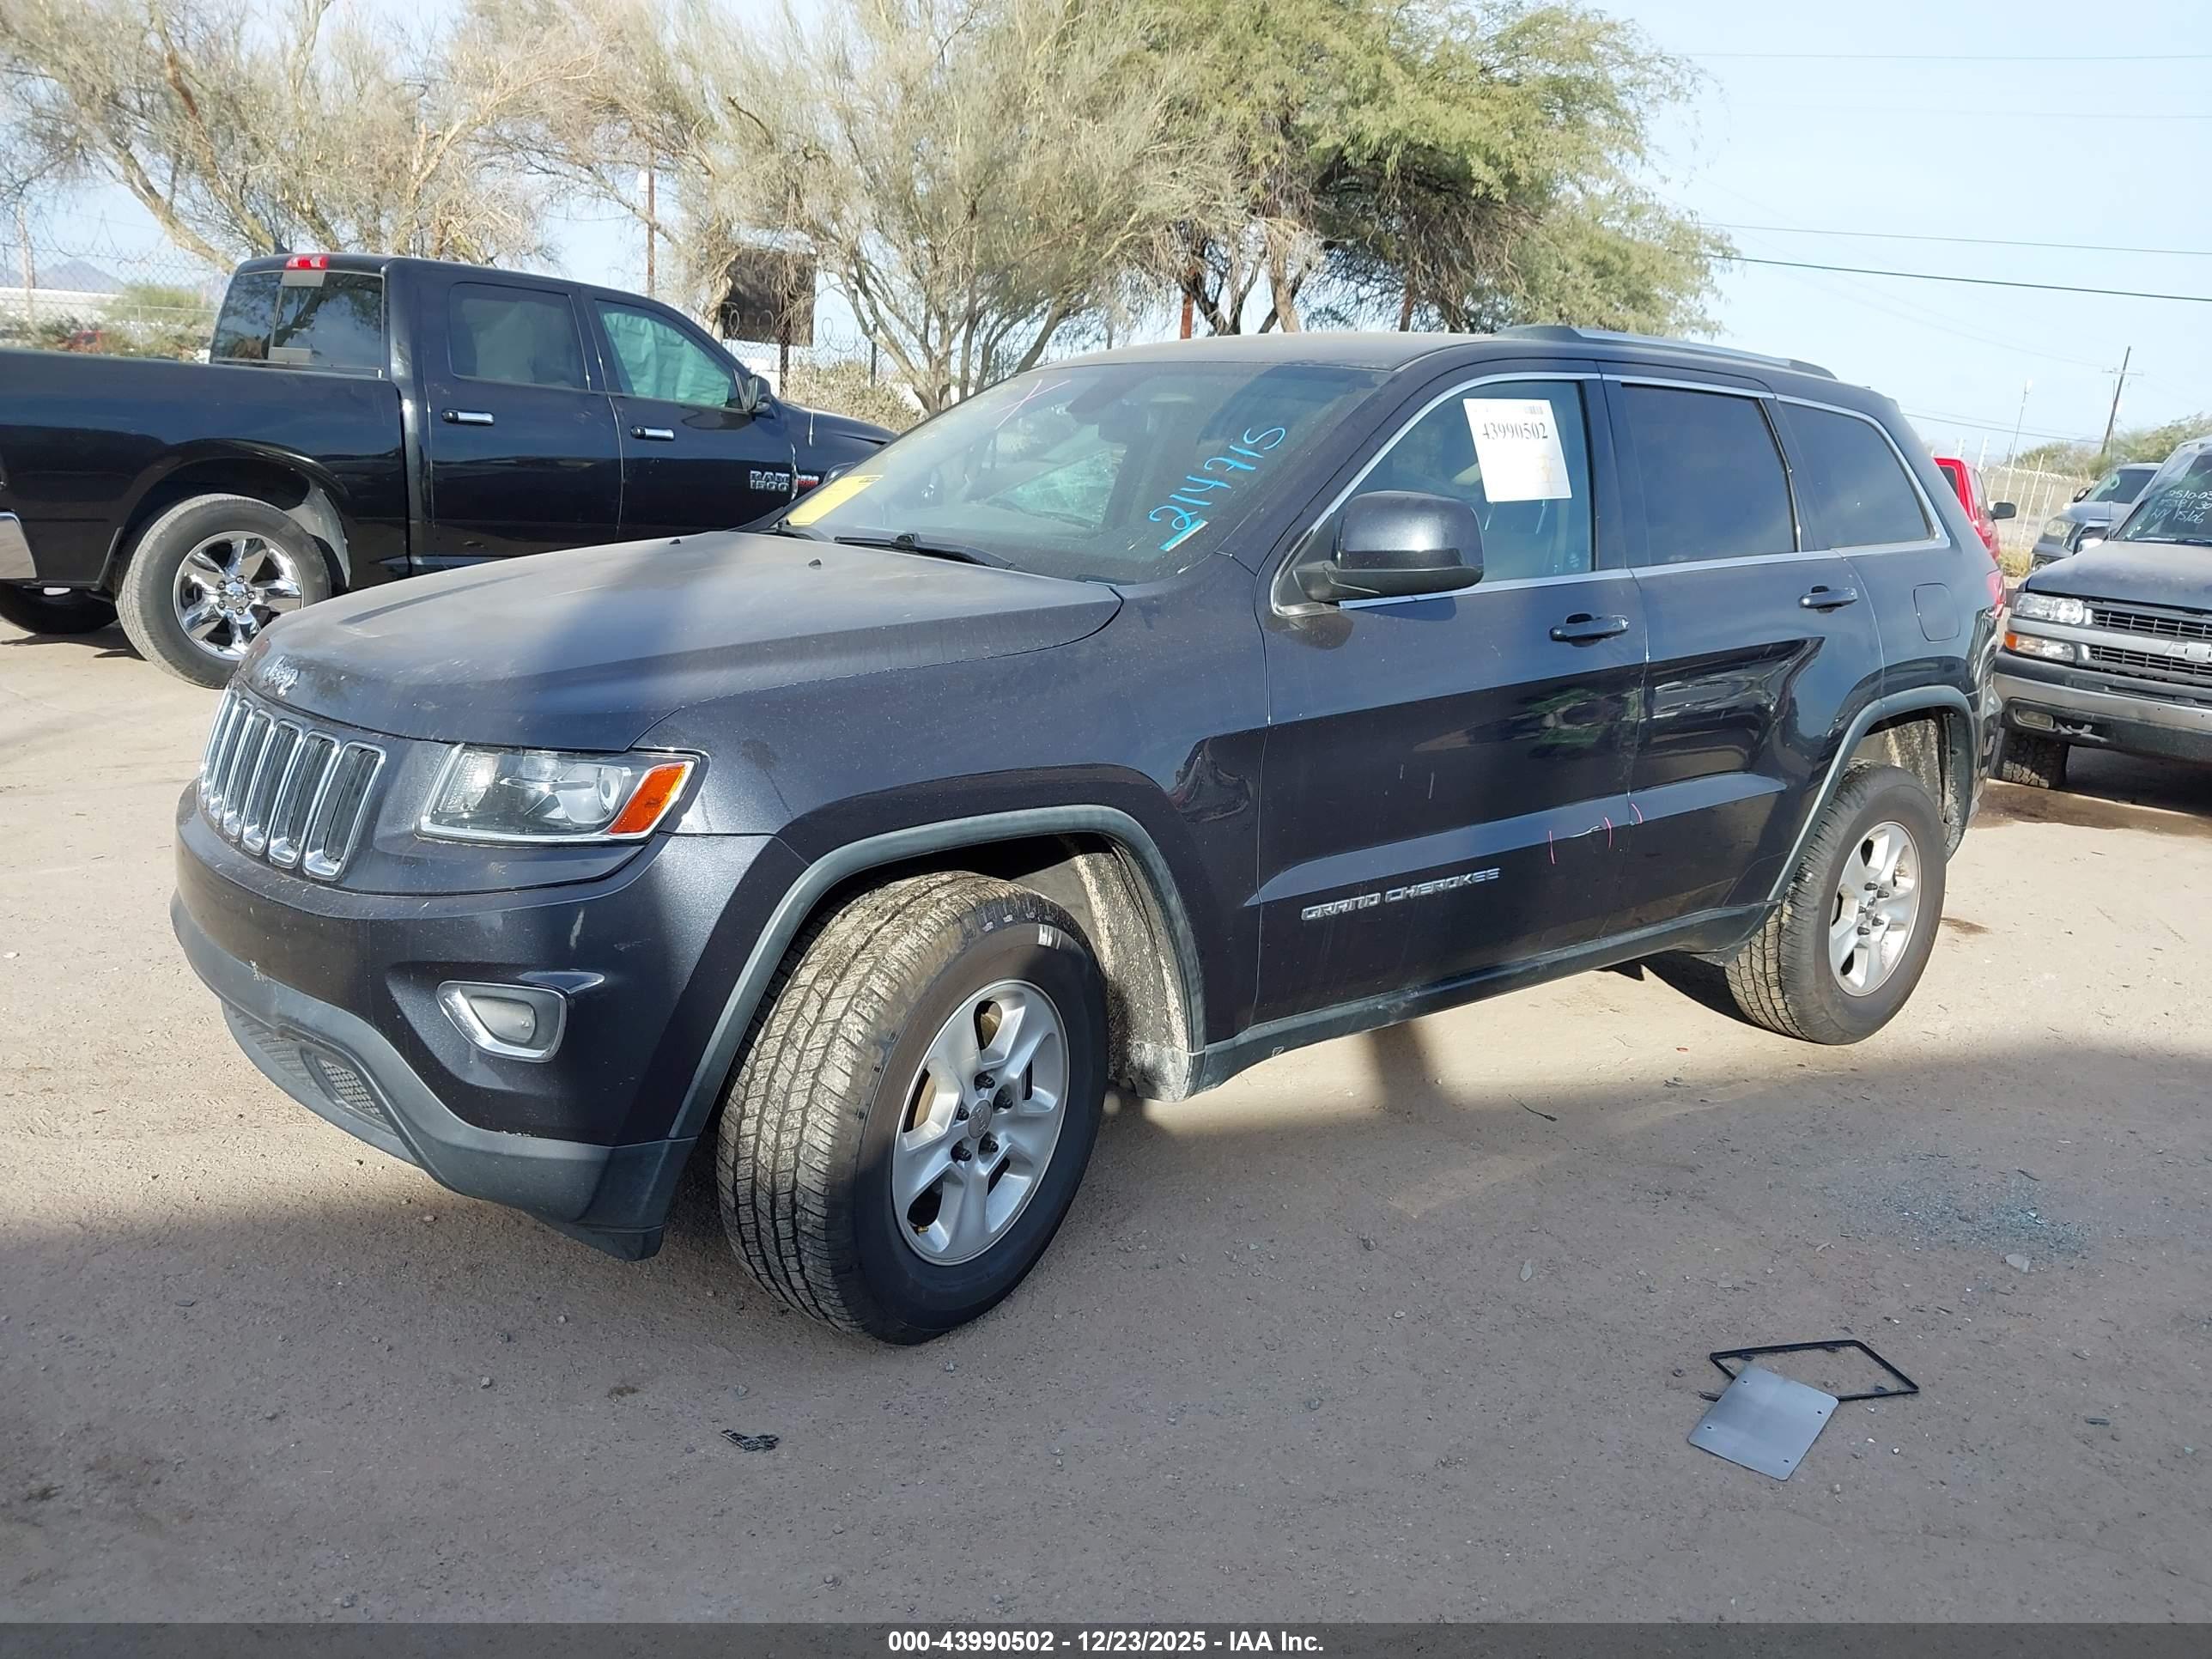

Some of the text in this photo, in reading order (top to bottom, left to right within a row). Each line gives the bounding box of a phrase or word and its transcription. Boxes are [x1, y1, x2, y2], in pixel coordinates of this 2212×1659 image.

[1482, 422, 1548, 440] 43990502
[750, 470, 790, 482] RAM
[1301, 867, 1501, 921] GRAND CHEROKEE
